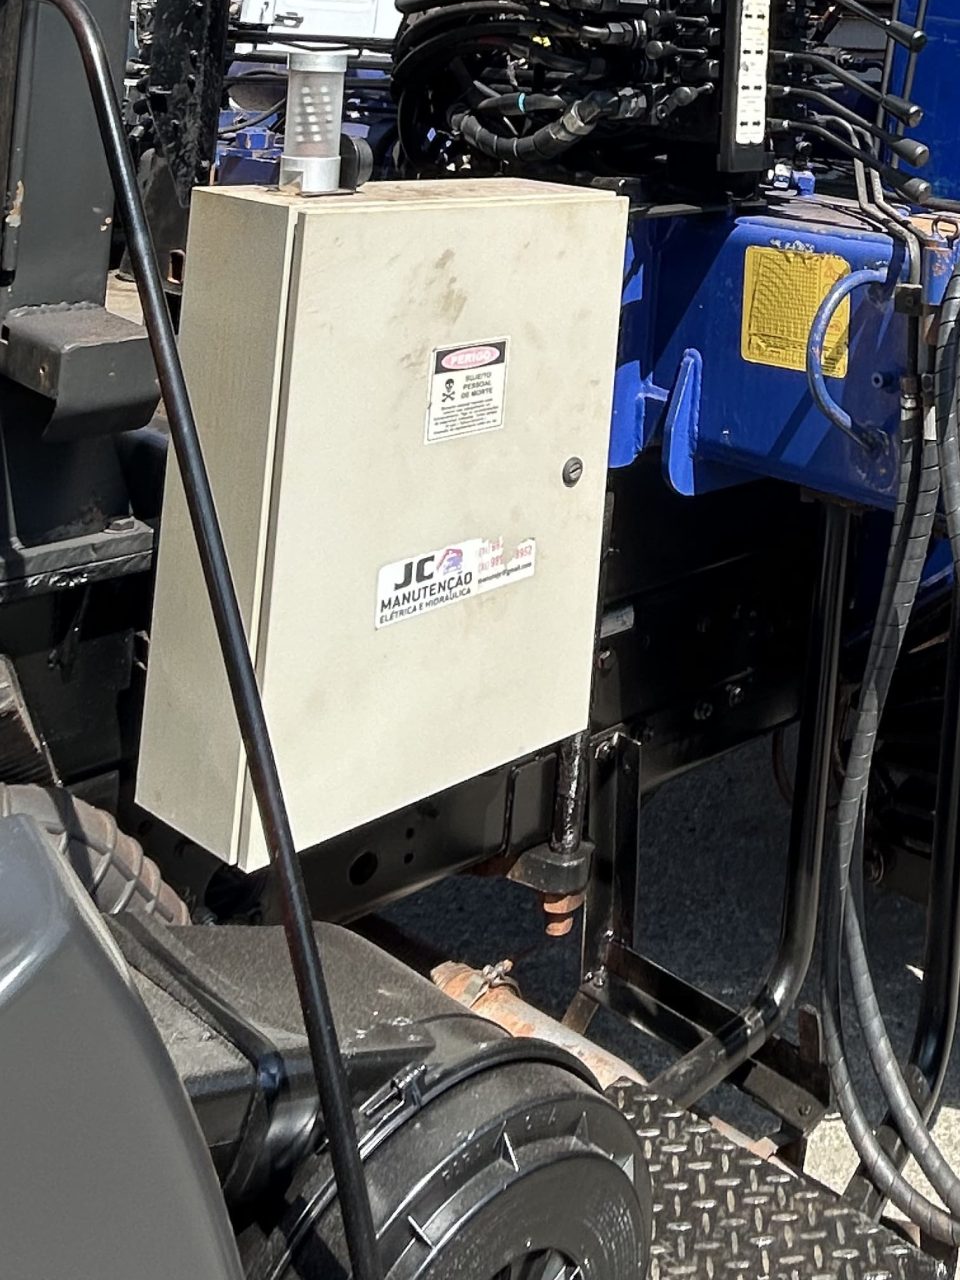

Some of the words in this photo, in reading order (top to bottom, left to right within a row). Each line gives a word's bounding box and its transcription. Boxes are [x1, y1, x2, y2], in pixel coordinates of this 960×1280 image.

[450, 350, 491, 365] PERIGO
[471, 387, 493, 396] MORTE
[394, 554, 435, 591] JC
[379, 605, 417, 624] ELÉTRICA
[418, 603, 423, 611] E
[425, 587, 471, 608] HIDRÁULICA
[380, 570, 473, 613] MANUTENÇÃO
